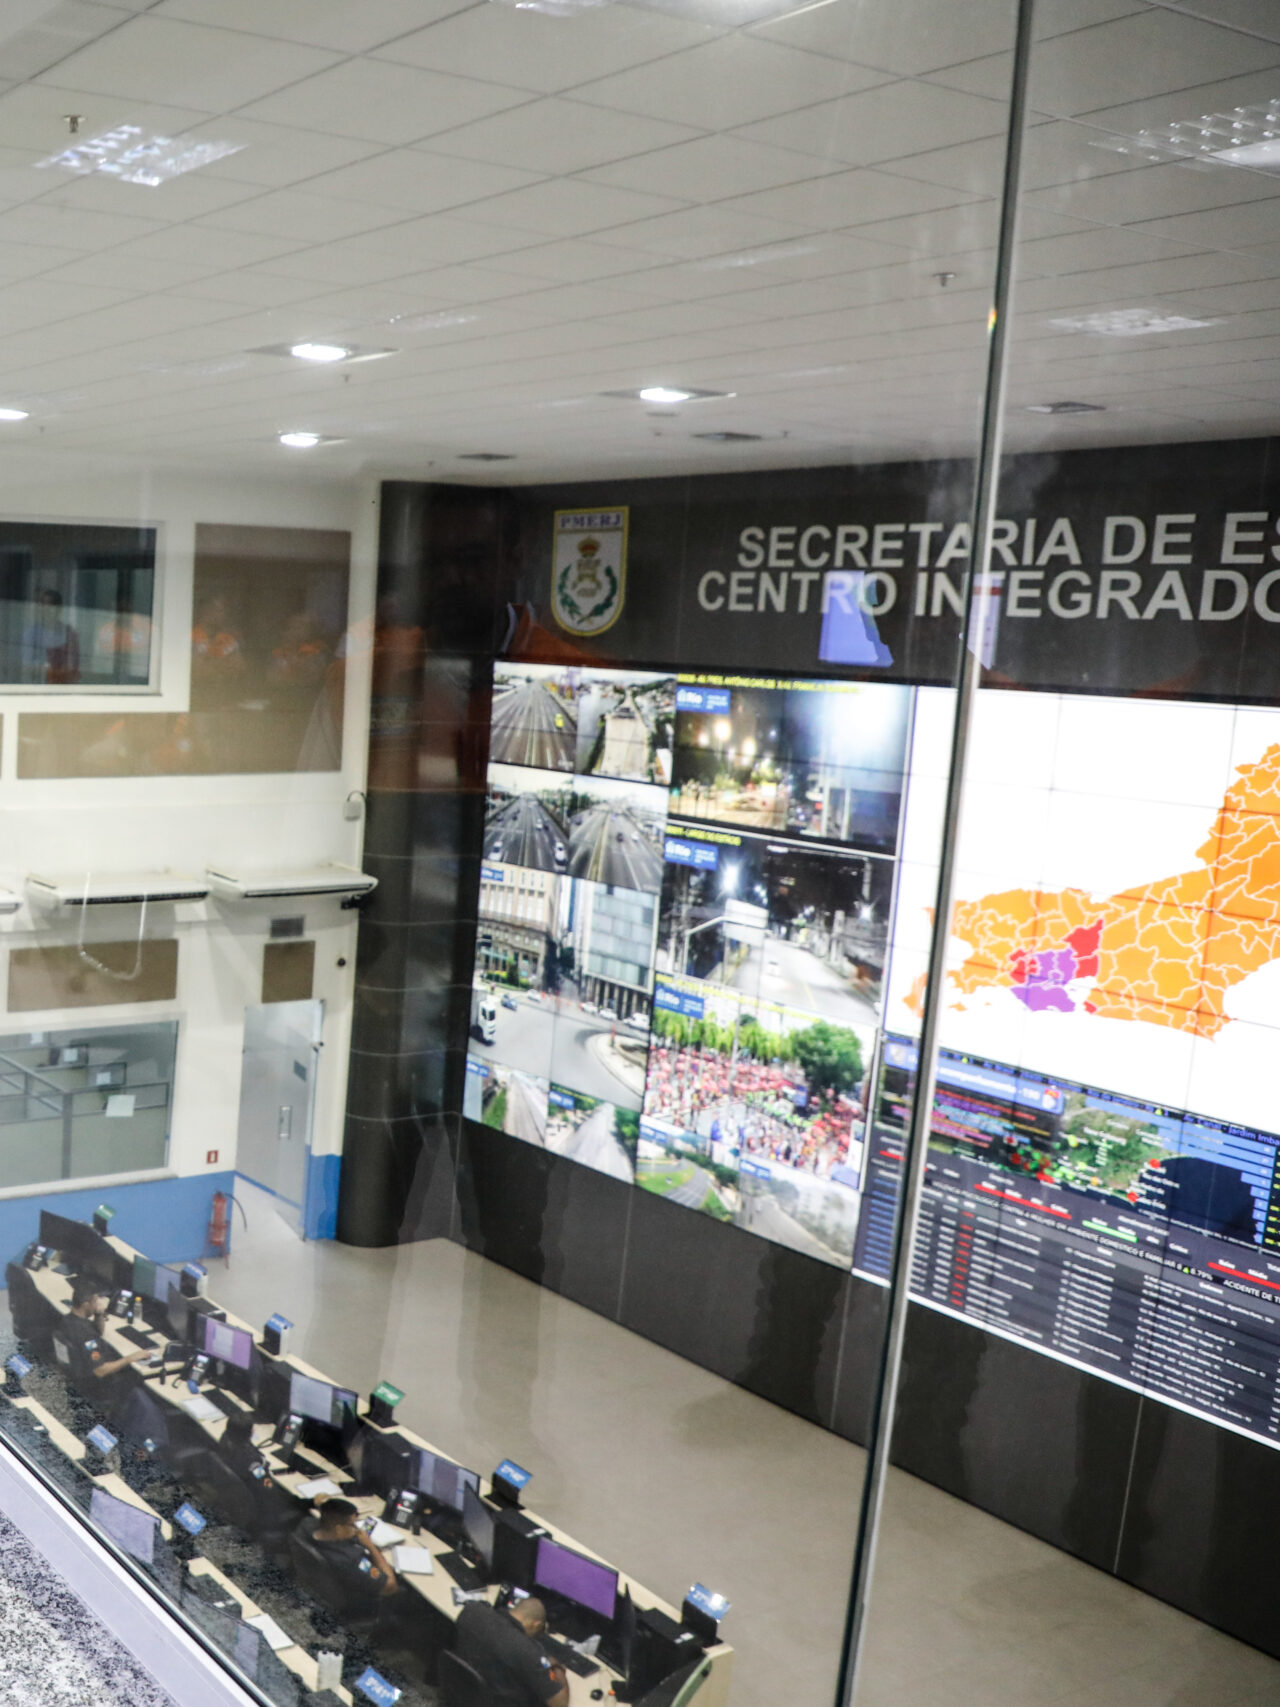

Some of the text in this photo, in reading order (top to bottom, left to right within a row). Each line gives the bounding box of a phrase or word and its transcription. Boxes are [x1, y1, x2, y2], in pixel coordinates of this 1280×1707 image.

[561, 514, 621, 528] PMERJ
[737, 511, 1280, 568] SECRETARIA DE E
[697, 570, 897, 616] CENTRO
[1228, 1125, 1257, 1140] Jardim
[1223, 1279, 1261, 1298] ACIDENTE
